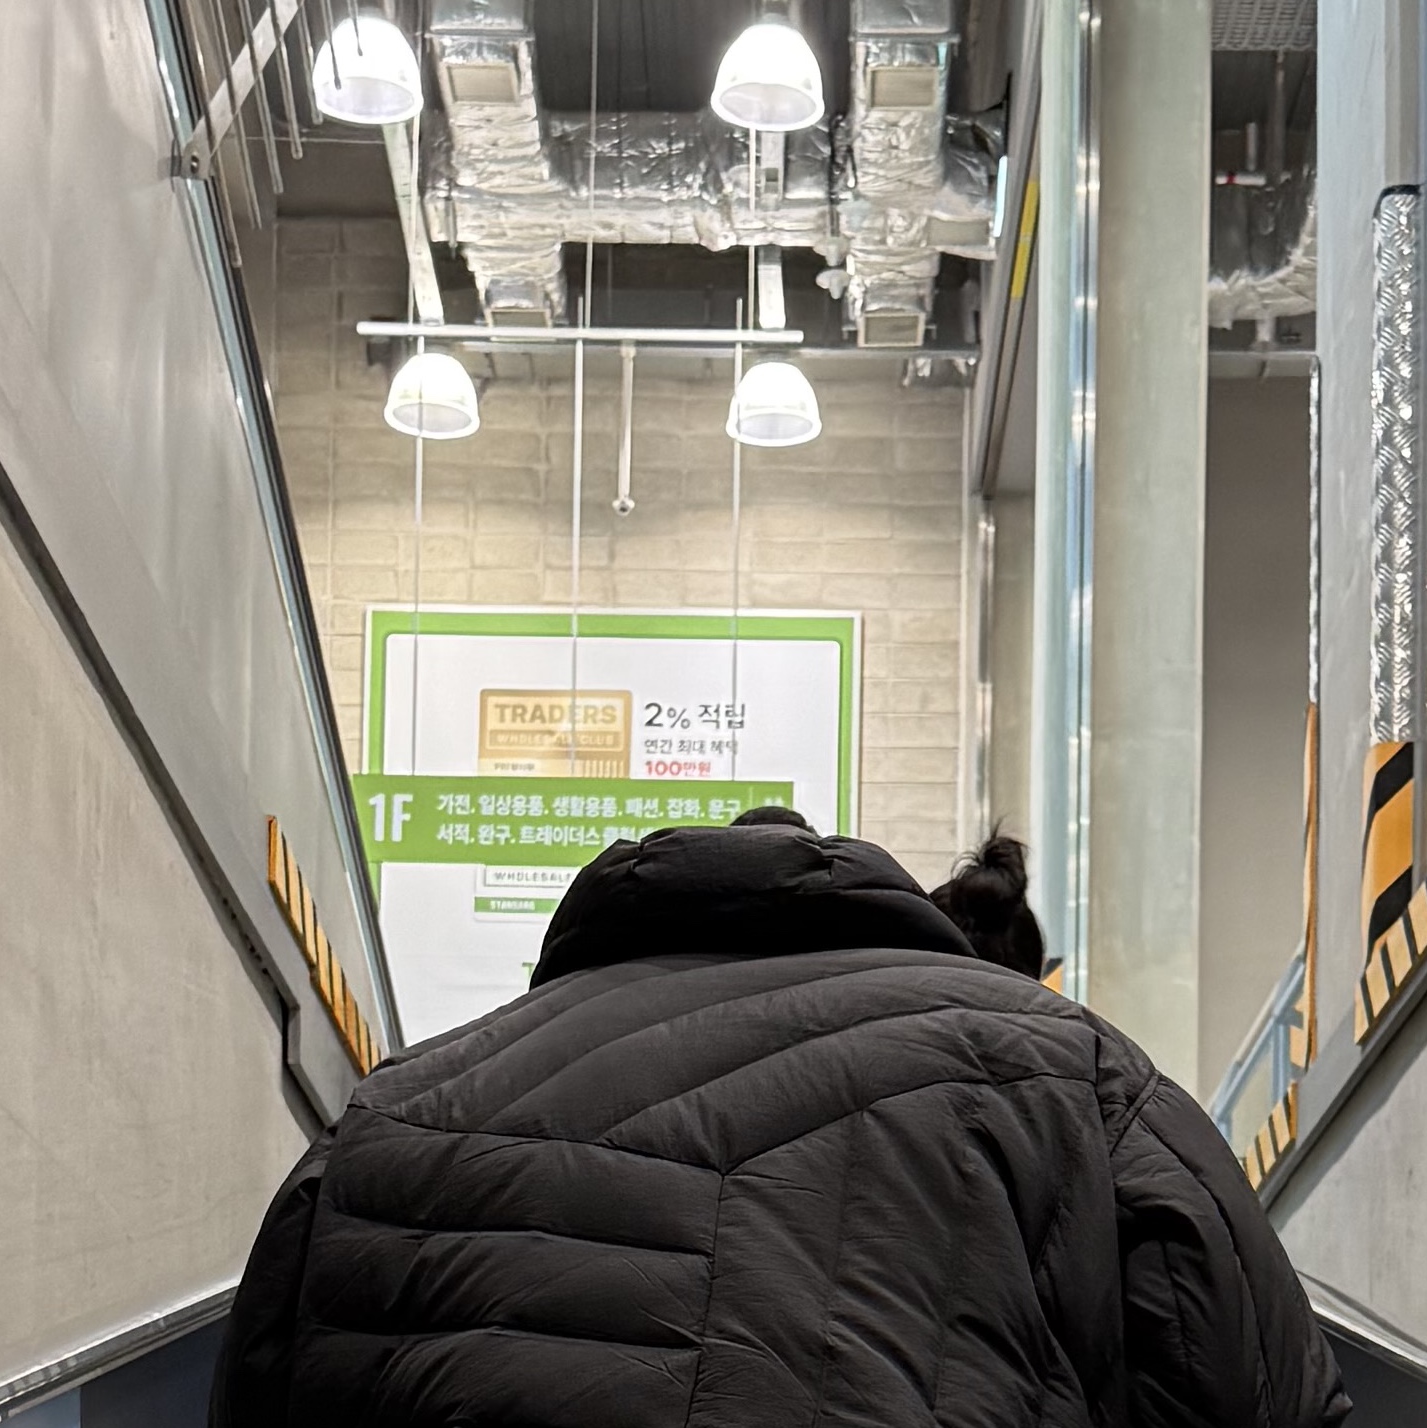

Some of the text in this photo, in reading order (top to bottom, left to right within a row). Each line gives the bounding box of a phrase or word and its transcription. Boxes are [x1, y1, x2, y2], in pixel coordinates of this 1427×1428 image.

[493, 703, 618, 725] TRADERS
[644, 702, 746, 729] 2% 적립
[644, 739, 673, 754] 연간
[645, 761, 711, 777] 100만원
[369, 793, 414, 842] 1F
[519, 825, 600, 847] 트레이더스
